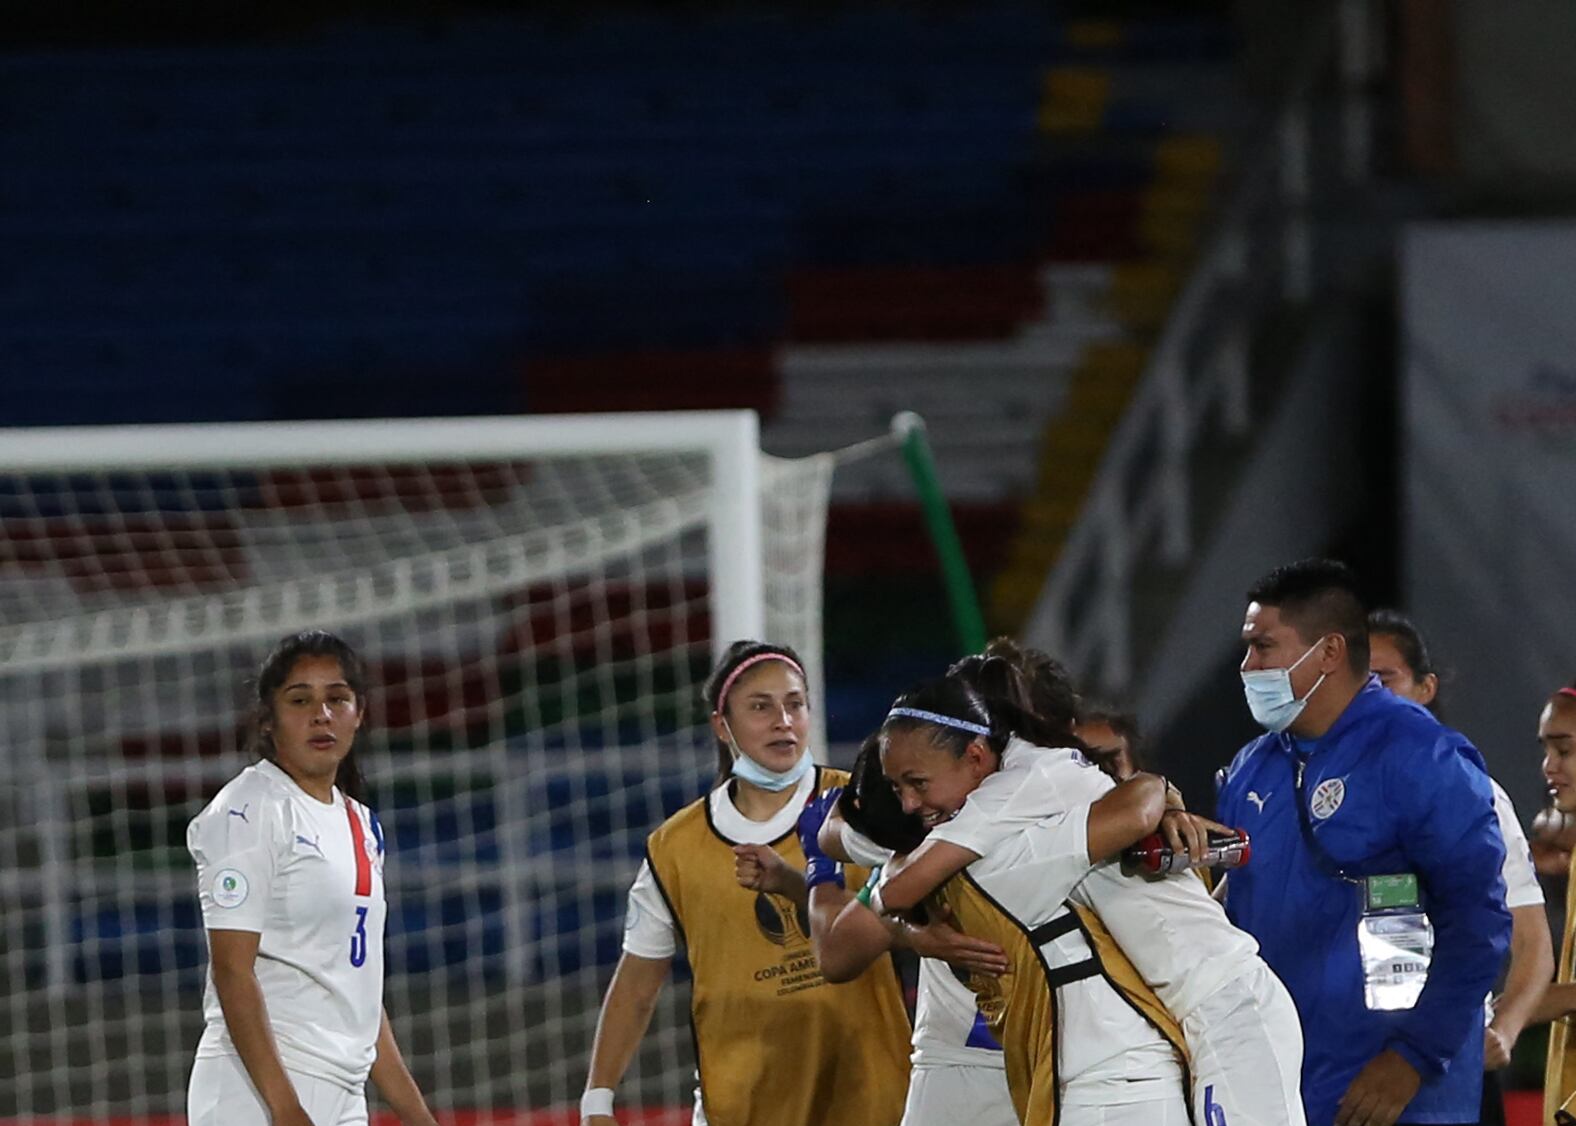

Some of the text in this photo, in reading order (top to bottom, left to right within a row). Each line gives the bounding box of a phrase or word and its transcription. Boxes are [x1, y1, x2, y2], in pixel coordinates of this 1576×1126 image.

[350, 906, 369, 968] 3
[754, 956, 817, 982] COPA AME
